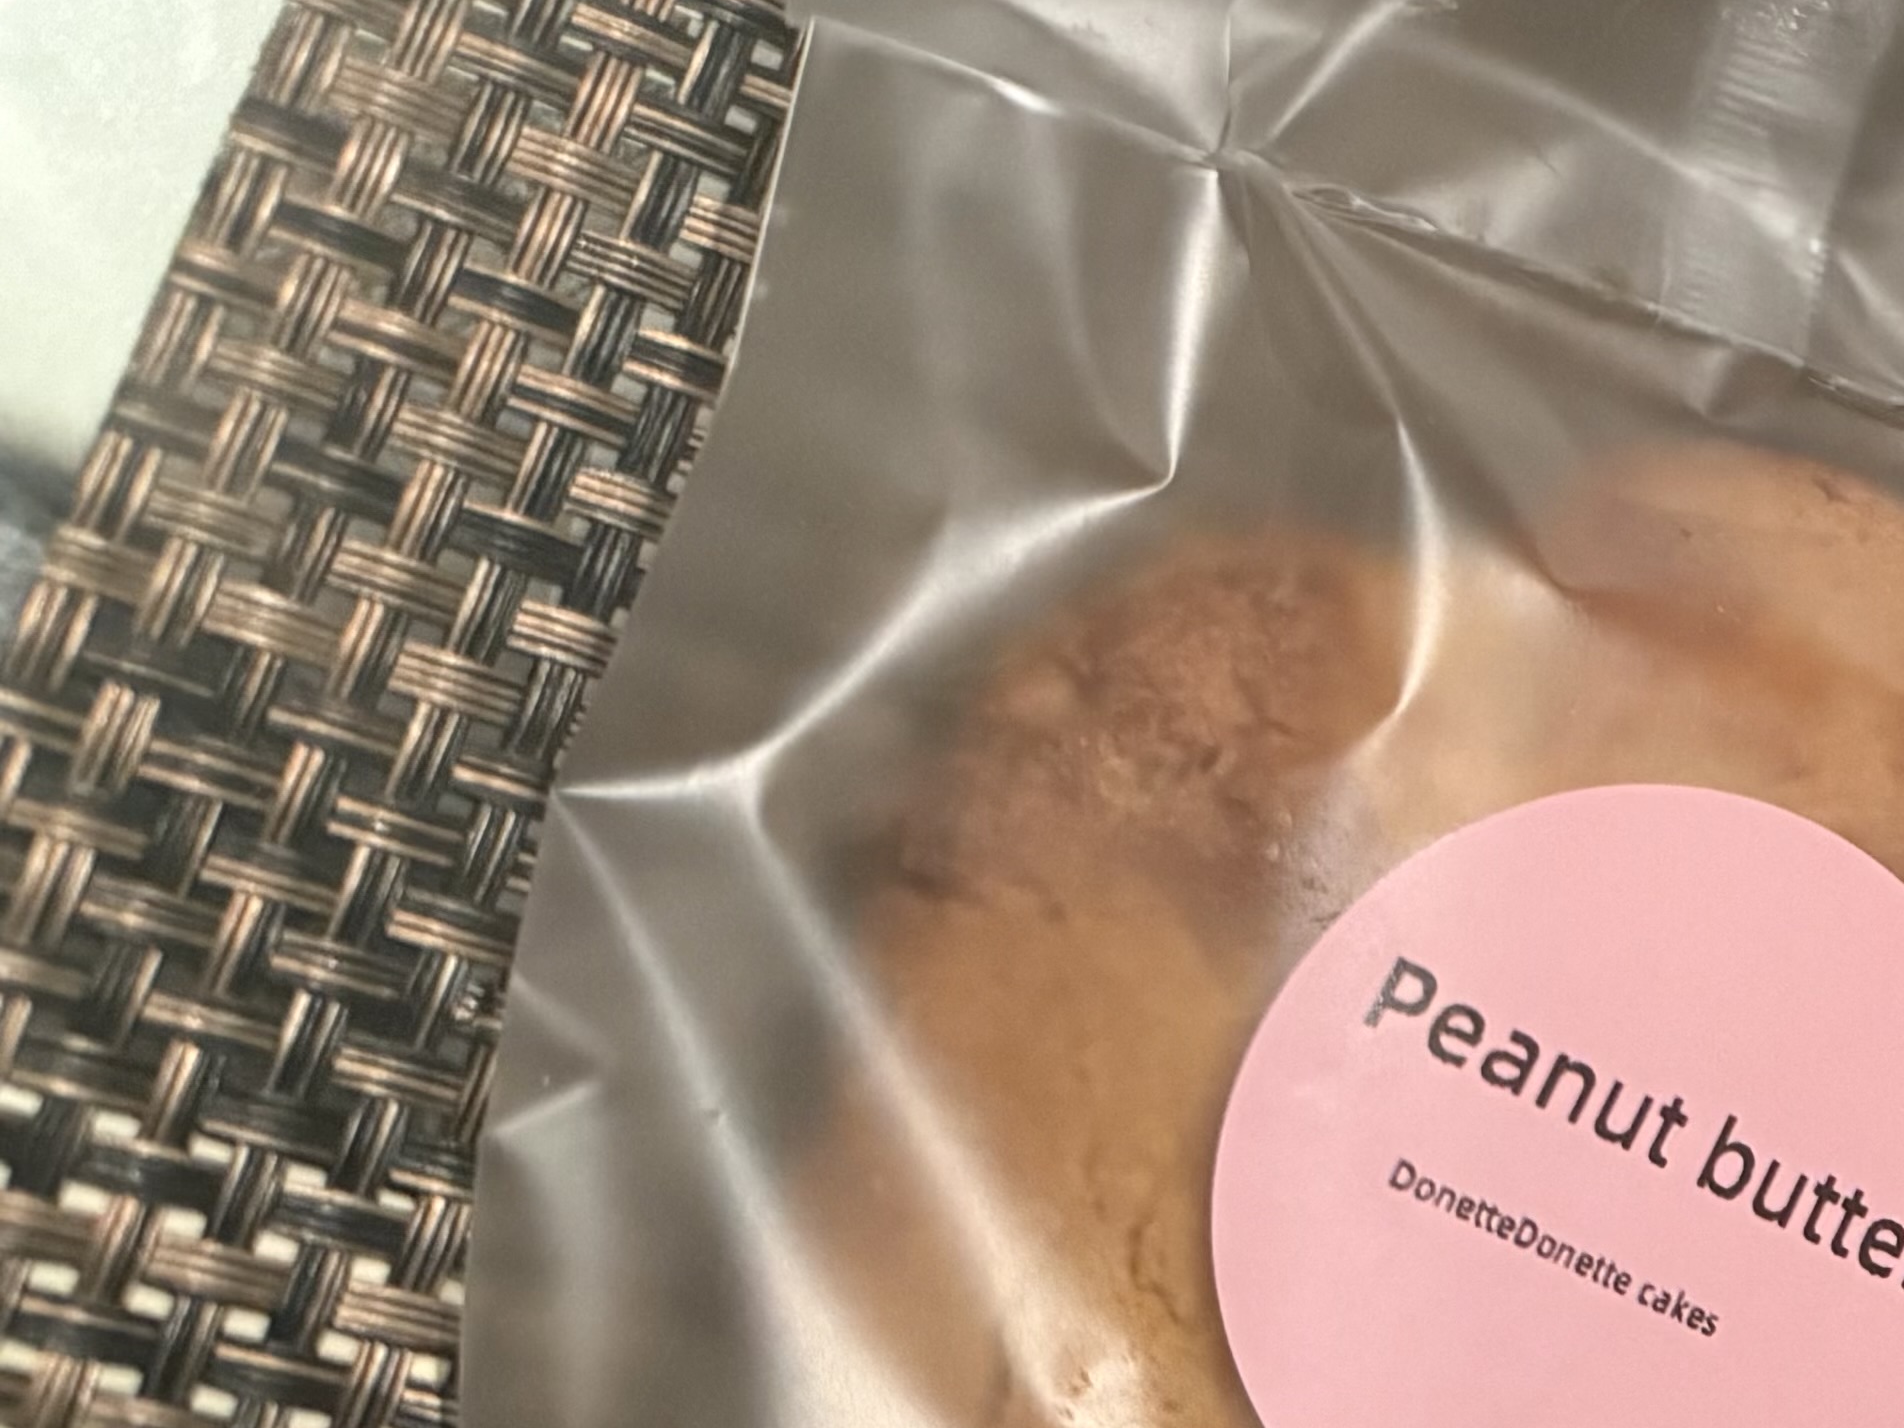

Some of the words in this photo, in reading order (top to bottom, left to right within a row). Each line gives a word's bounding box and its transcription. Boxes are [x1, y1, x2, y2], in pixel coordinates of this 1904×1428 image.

[1366, 957, 1688, 1168] Peanut
[1389, 1159, 1632, 1295] DonetteDonette
[1638, 1284, 1718, 1336] cakes
